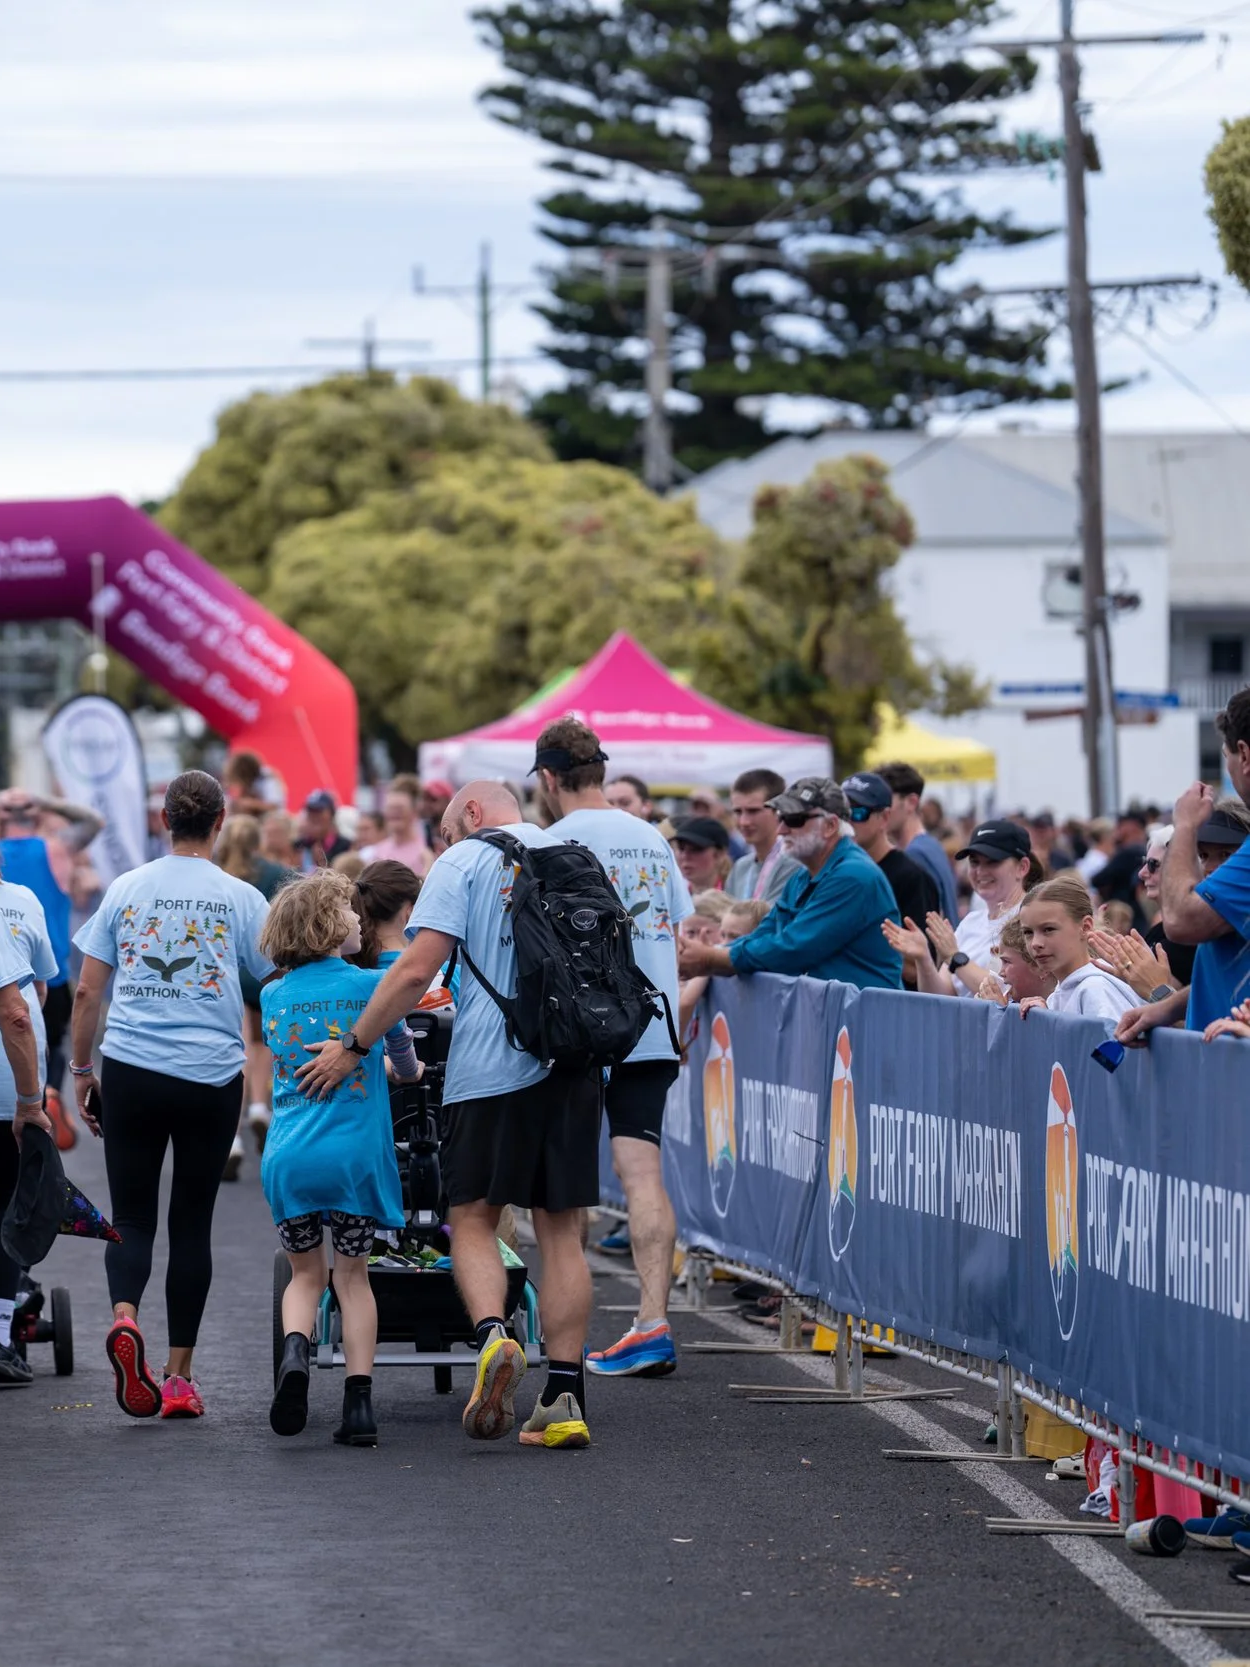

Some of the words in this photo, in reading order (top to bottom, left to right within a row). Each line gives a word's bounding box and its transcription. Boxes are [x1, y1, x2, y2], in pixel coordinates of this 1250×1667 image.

[245, 625, 293, 670] Bank
[119, 610, 208, 685] Bendigo
[203, 672, 260, 722] Bank
[609, 848, 638, 859] PORT
[154, 899, 193, 912] PORT
[118, 986, 181, 999] MARATHON
[292, 1001, 331, 1015] PORT
[335, 1000, 368, 1012] FAIR
[869, 1103, 903, 1206] PORT
[905, 1110, 948, 1218] FAIRY
